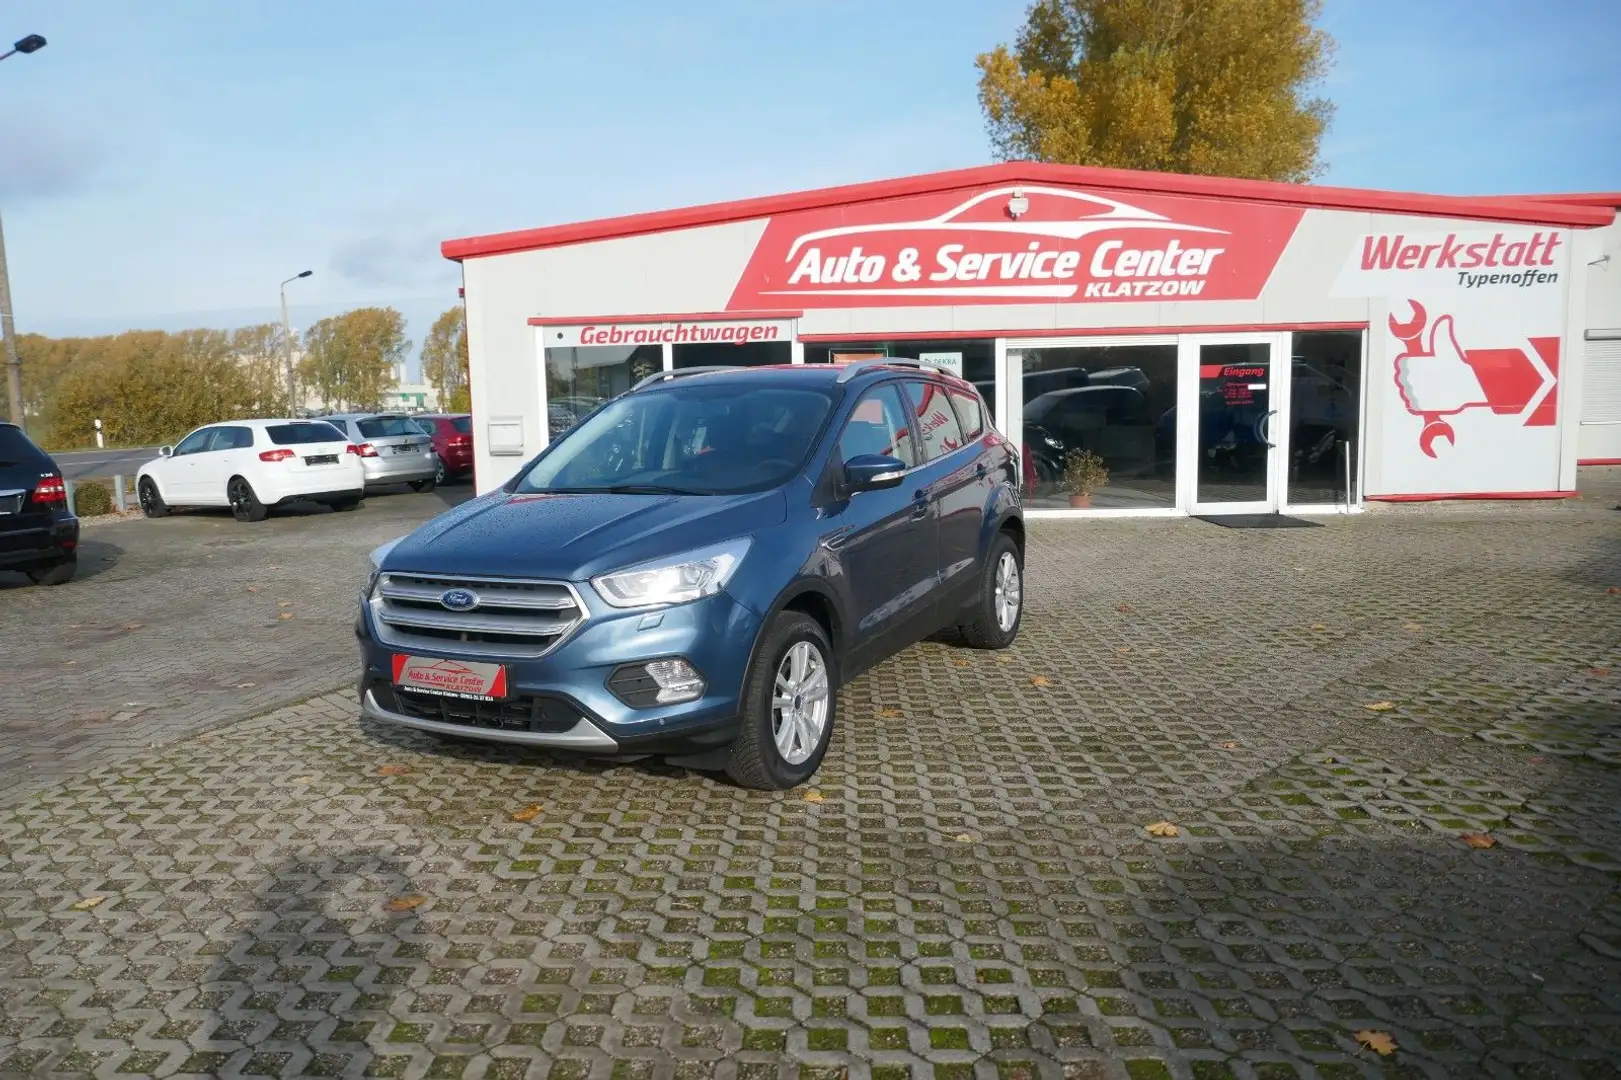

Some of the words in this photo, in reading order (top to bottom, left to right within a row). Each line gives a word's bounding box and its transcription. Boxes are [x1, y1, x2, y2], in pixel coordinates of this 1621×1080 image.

[1360, 232, 1563, 270] Werkstatt
[788, 248, 887, 285] Auto
[891, 249, 922, 282] &
[929, 241, 1080, 281] Service
[1090, 240, 1225, 278] Center
[1457, 270, 1559, 288] Typenoffen
[1084, 281, 1206, 298] KLATZOW
[580, 324, 779, 346] Gebrauchtwagen
[933, 358, 957, 366] DEKRA
[1223, 367, 1265, 377] Eingang
[447, 593, 468, 605] Ford
[407, 670, 424, 679] Auto
[432, 672, 458, 683] Service
[460, 675, 485, 686] Center
